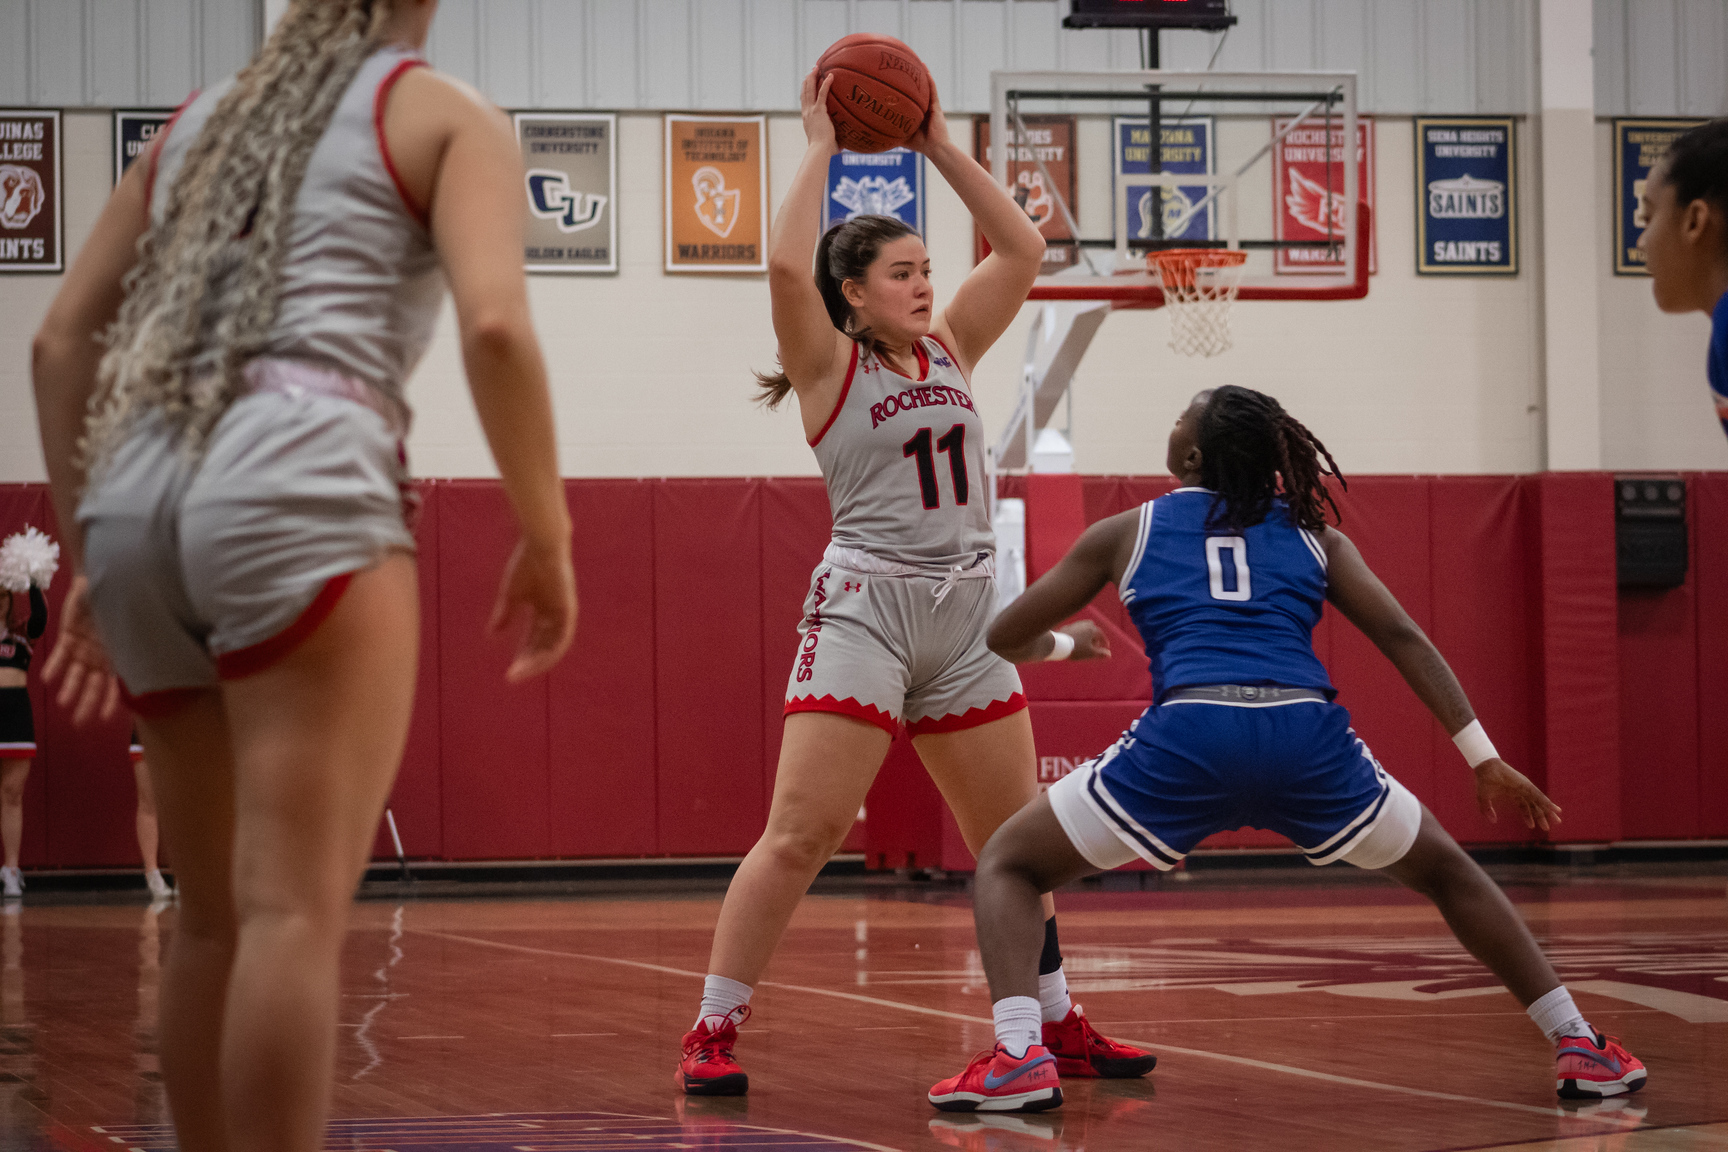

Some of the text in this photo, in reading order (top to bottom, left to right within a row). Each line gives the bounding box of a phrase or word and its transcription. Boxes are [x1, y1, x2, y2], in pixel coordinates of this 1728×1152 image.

[846, 84, 915, 133] SPALDING
[526, 126, 604, 138] CORNERSTONE
[0, 142, 43, 160] LEGE
[531, 142, 598, 154] UNIVERSITY
[1435, 145, 1496, 157] UNIVERSITY
[1432, 194, 1499, 214] SAINTS
[678, 244, 755, 260] WARRIORS
[1434, 241, 1501, 262] SAINTS
[870, 385, 978, 430] ROCHESTER
[903, 423, 969, 510] 11
[1205, 536, 1252, 601] 0
